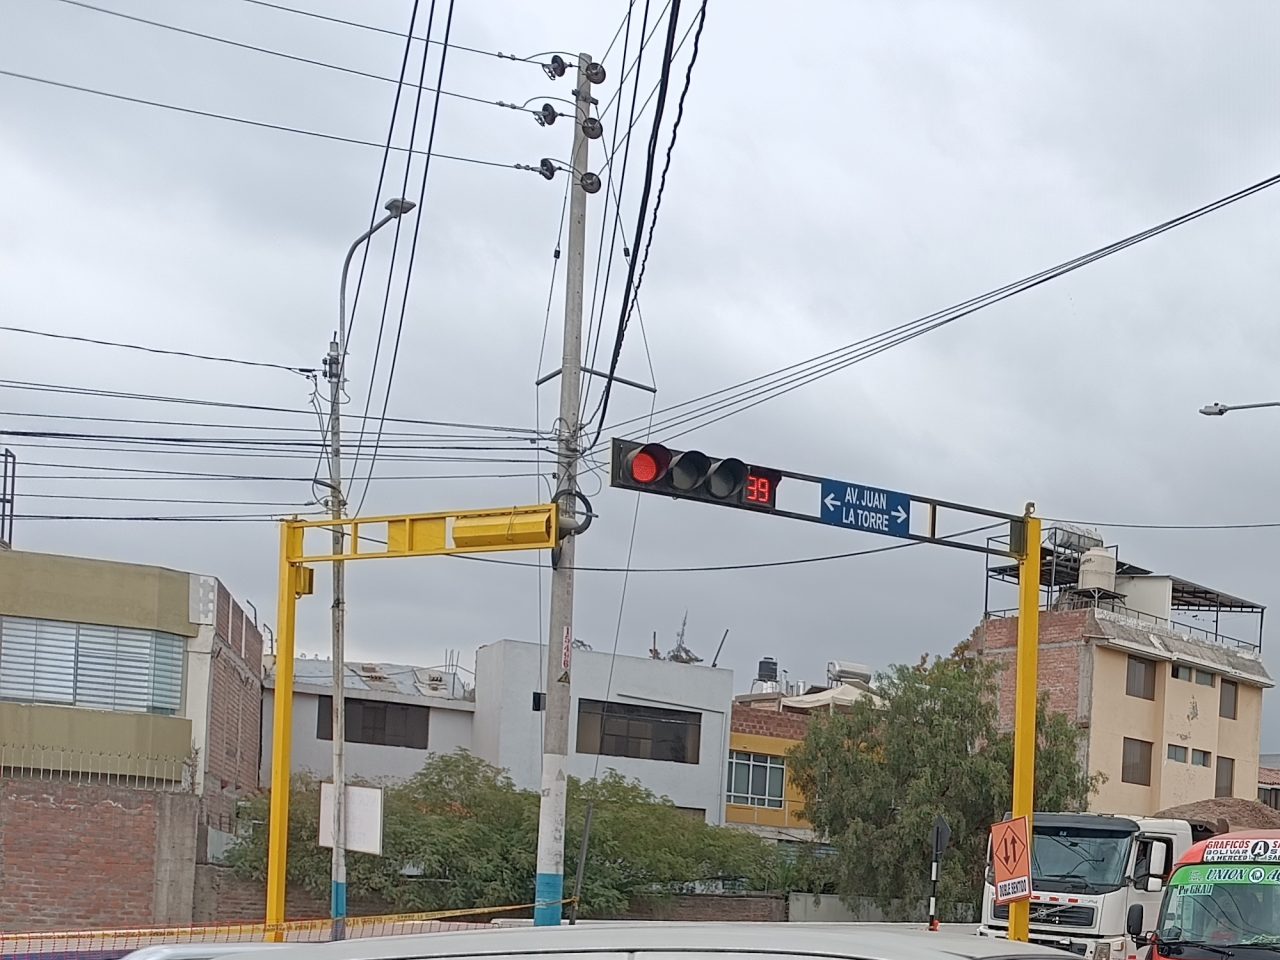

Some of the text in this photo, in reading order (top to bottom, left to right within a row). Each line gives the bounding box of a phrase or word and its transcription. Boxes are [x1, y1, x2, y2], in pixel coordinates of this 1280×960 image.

[747, 477, 768, 502] 39
[845, 487, 887, 509] AV. JUAN
[842, 507, 889, 531] LA TORRE
[1206, 840, 1250, 849] GRAFICOS
[1207, 869, 1247, 881] UNION
